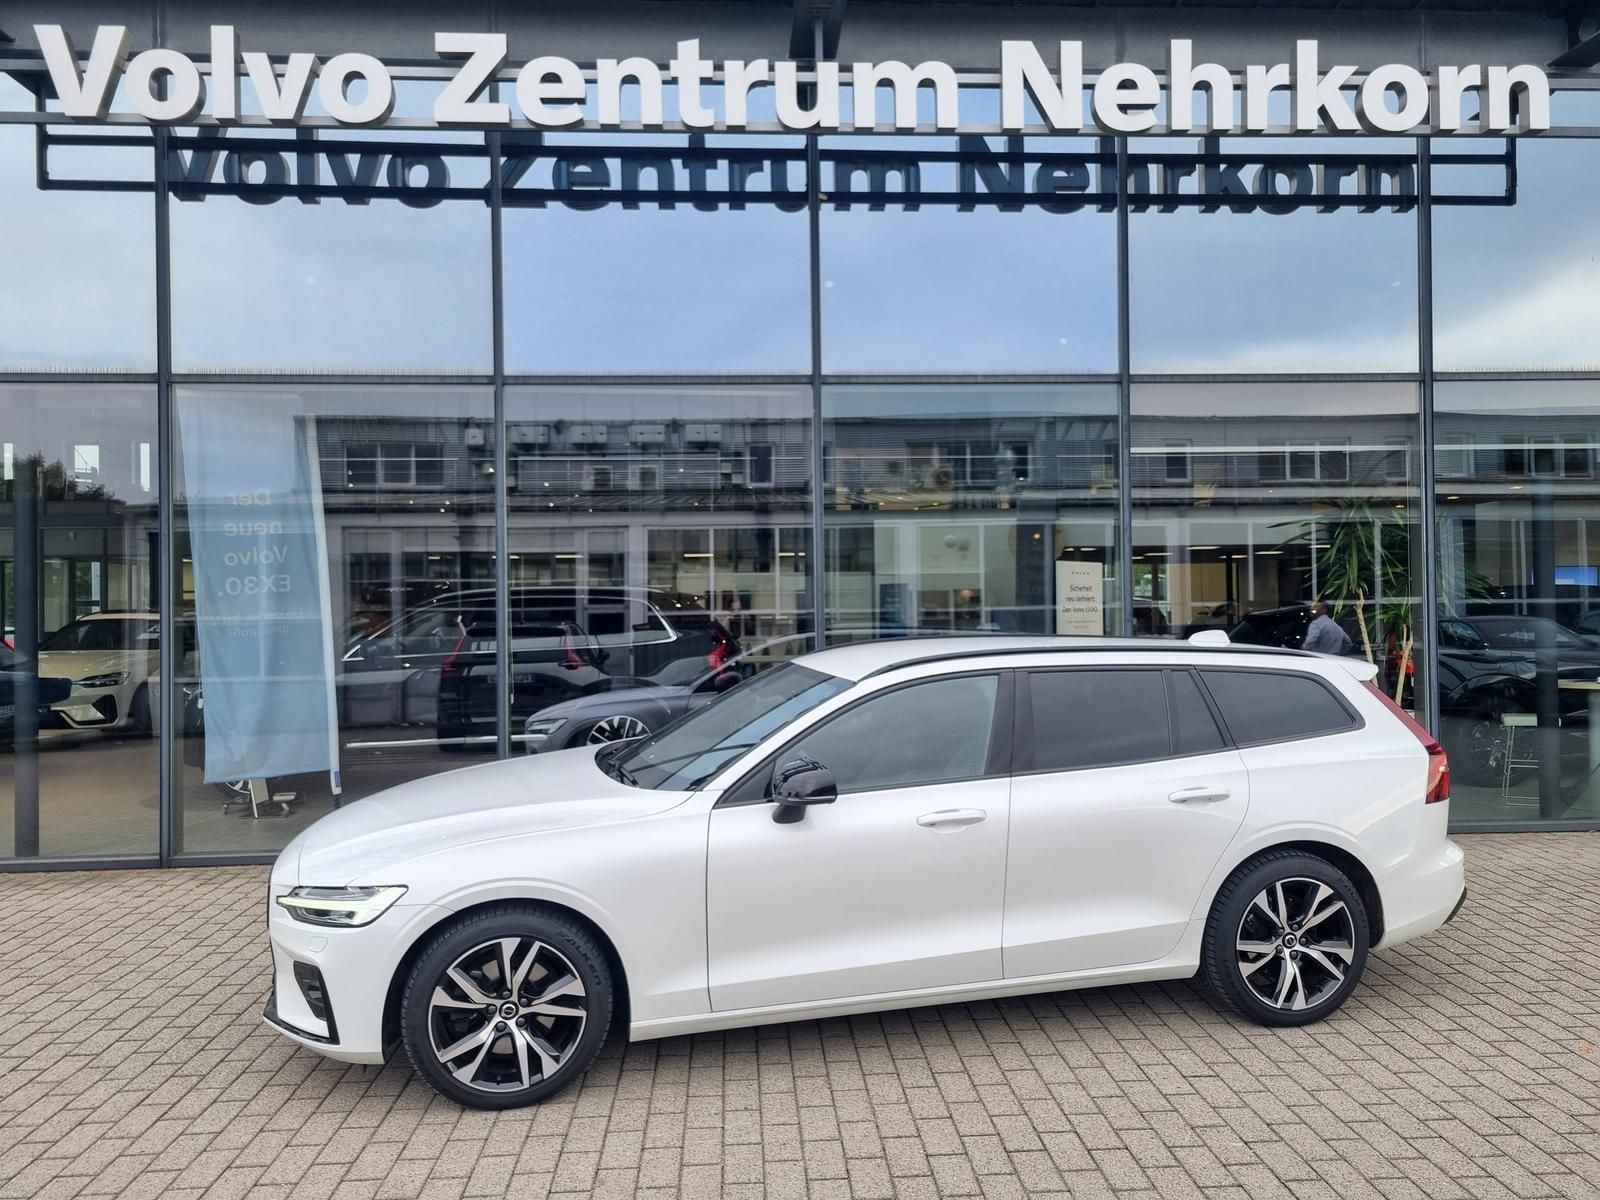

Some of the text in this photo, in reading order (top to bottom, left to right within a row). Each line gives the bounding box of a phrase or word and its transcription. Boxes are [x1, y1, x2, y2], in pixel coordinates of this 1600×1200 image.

[33, 24, 1551, 136] Volvo Zentrum Nehrkorn
[152, 126, 1416, 216] Volvo Zentrum Nehrkorn
